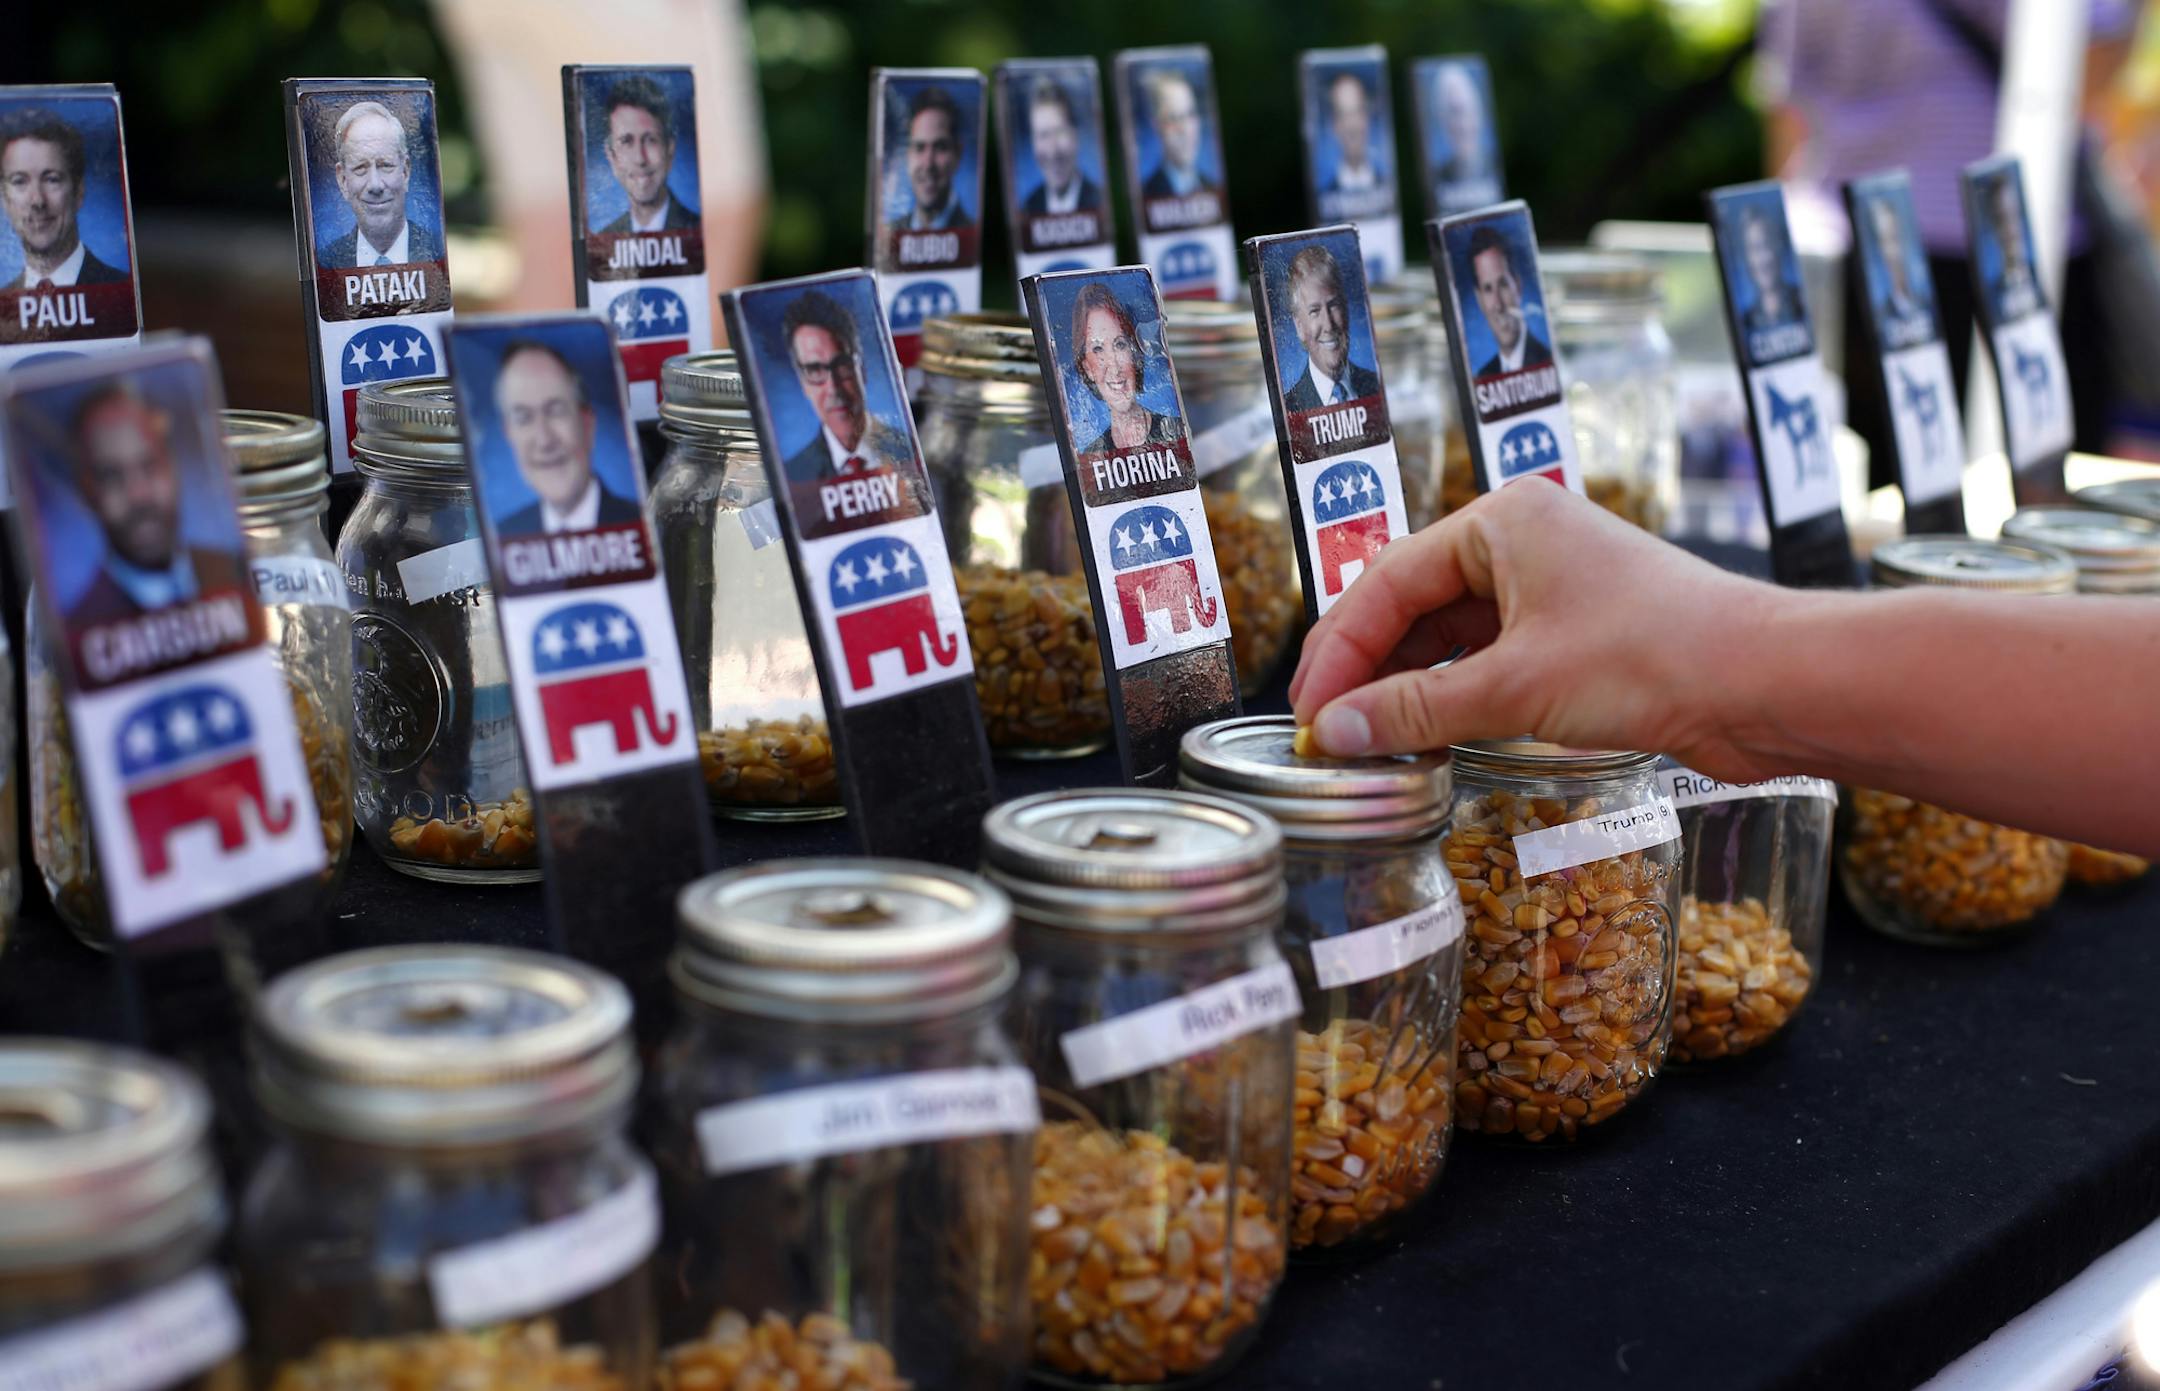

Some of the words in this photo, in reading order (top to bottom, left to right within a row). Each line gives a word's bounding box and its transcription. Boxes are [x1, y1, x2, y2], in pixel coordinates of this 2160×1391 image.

[608, 236, 688, 269] JINDAL
[344, 270, 427, 306] PATAKI
[18, 293, 95, 330] PAUL
[1477, 373, 1558, 414] SANTORUM
[1308, 406, 1368, 445] TRUMP
[1092, 449, 1182, 491] FIORINA
[820, 472, 899, 522] PERRY
[504, 529, 645, 585] GILMORE
[253, 568, 309, 593] Paul
[81, 595, 248, 681] CARSON
[1597, 810, 1654, 833] Trump
[1657, 802, 1671, 819] (9)
